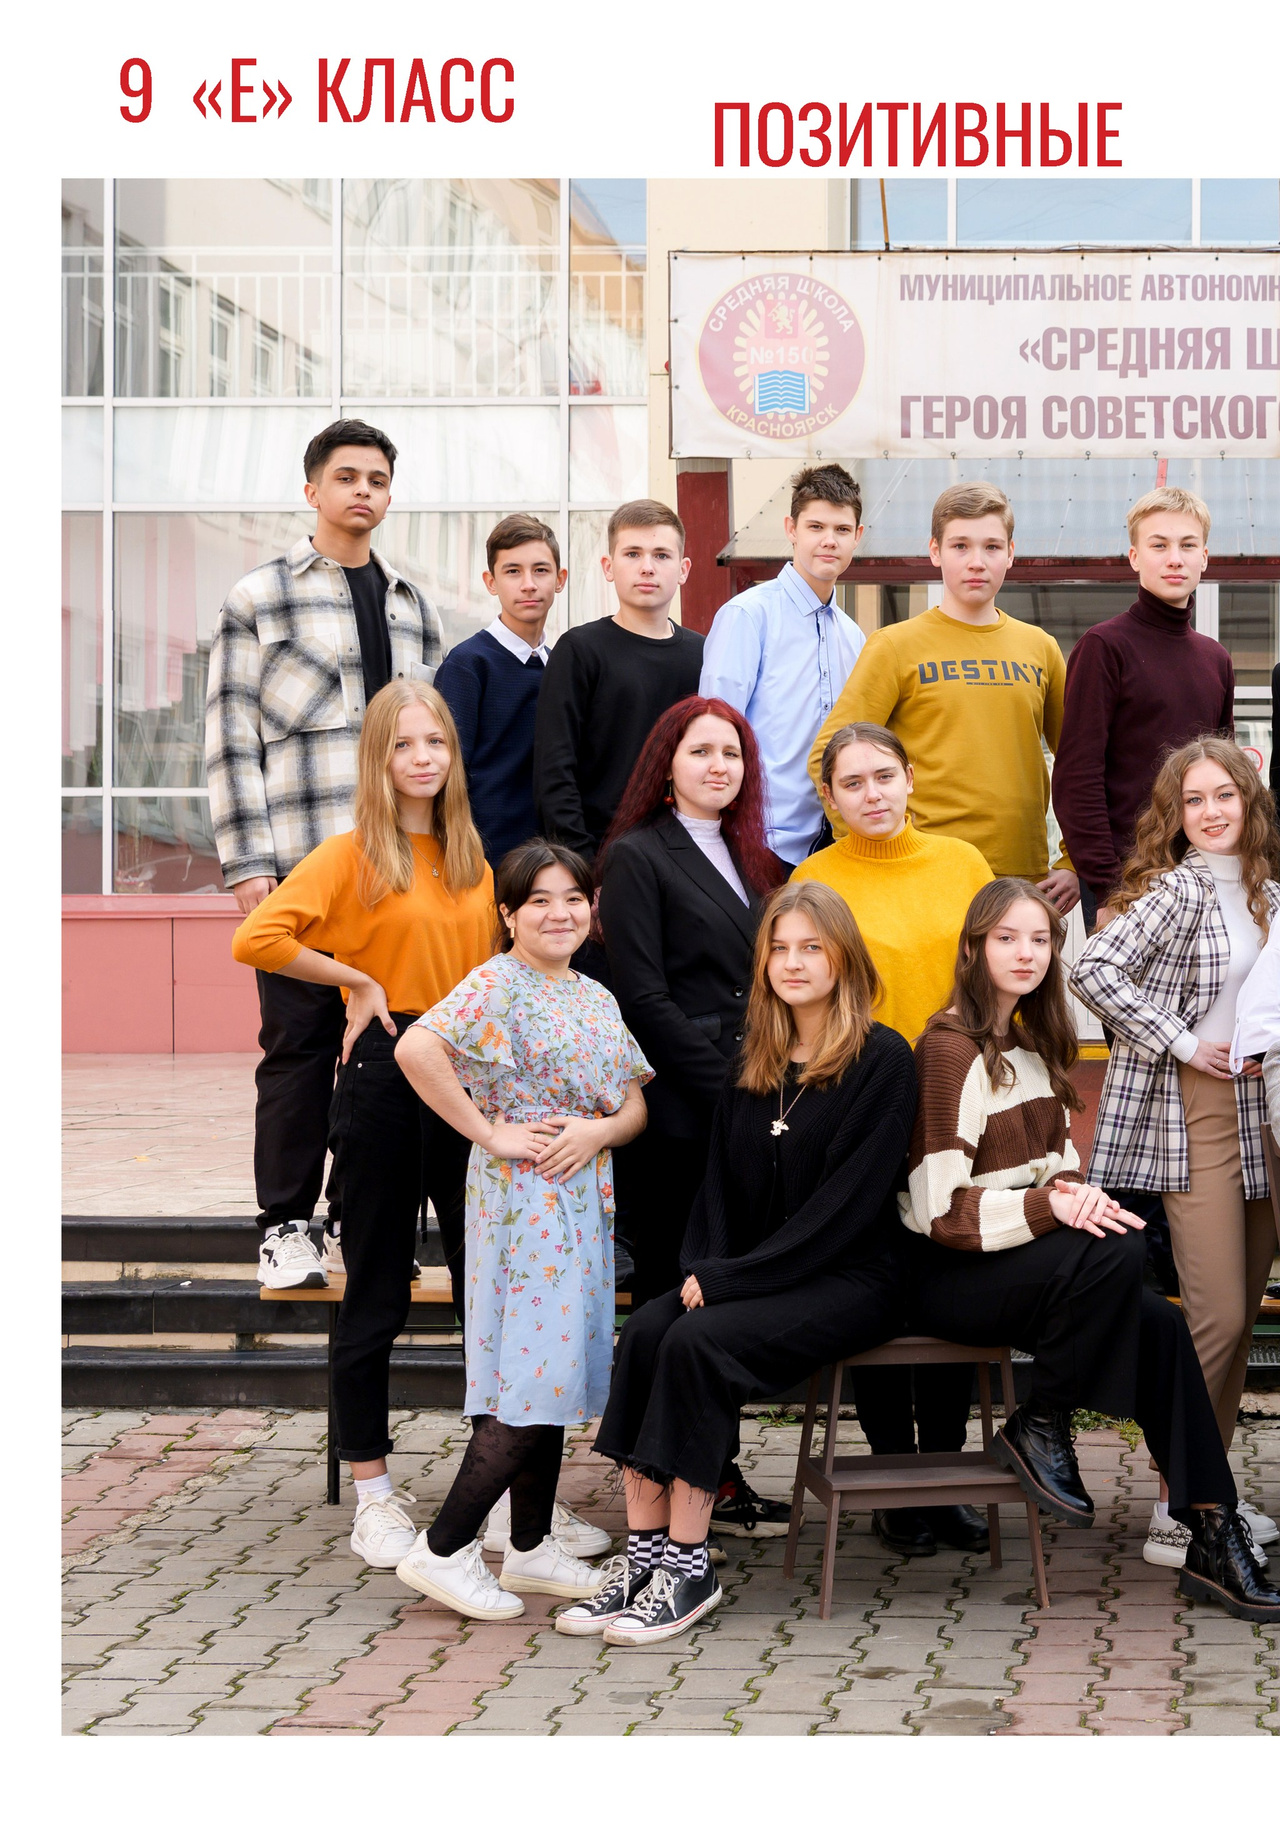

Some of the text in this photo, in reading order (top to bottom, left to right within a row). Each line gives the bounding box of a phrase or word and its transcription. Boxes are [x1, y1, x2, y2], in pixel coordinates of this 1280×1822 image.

[708, 276, 855, 333] СРЕДНЯЯ ШКОЛА
[900, 274, 1132, 305] МУНИЦИПАЛЬНОЕ
[1018, 327, 1232, 379] «СРЕДНЯЯ
[727, 403, 839, 437] КРАСНОЯРСК
[900, 395, 1027, 440] ГЕРОЯ
[918, 659, 1043, 687] DESTINY
